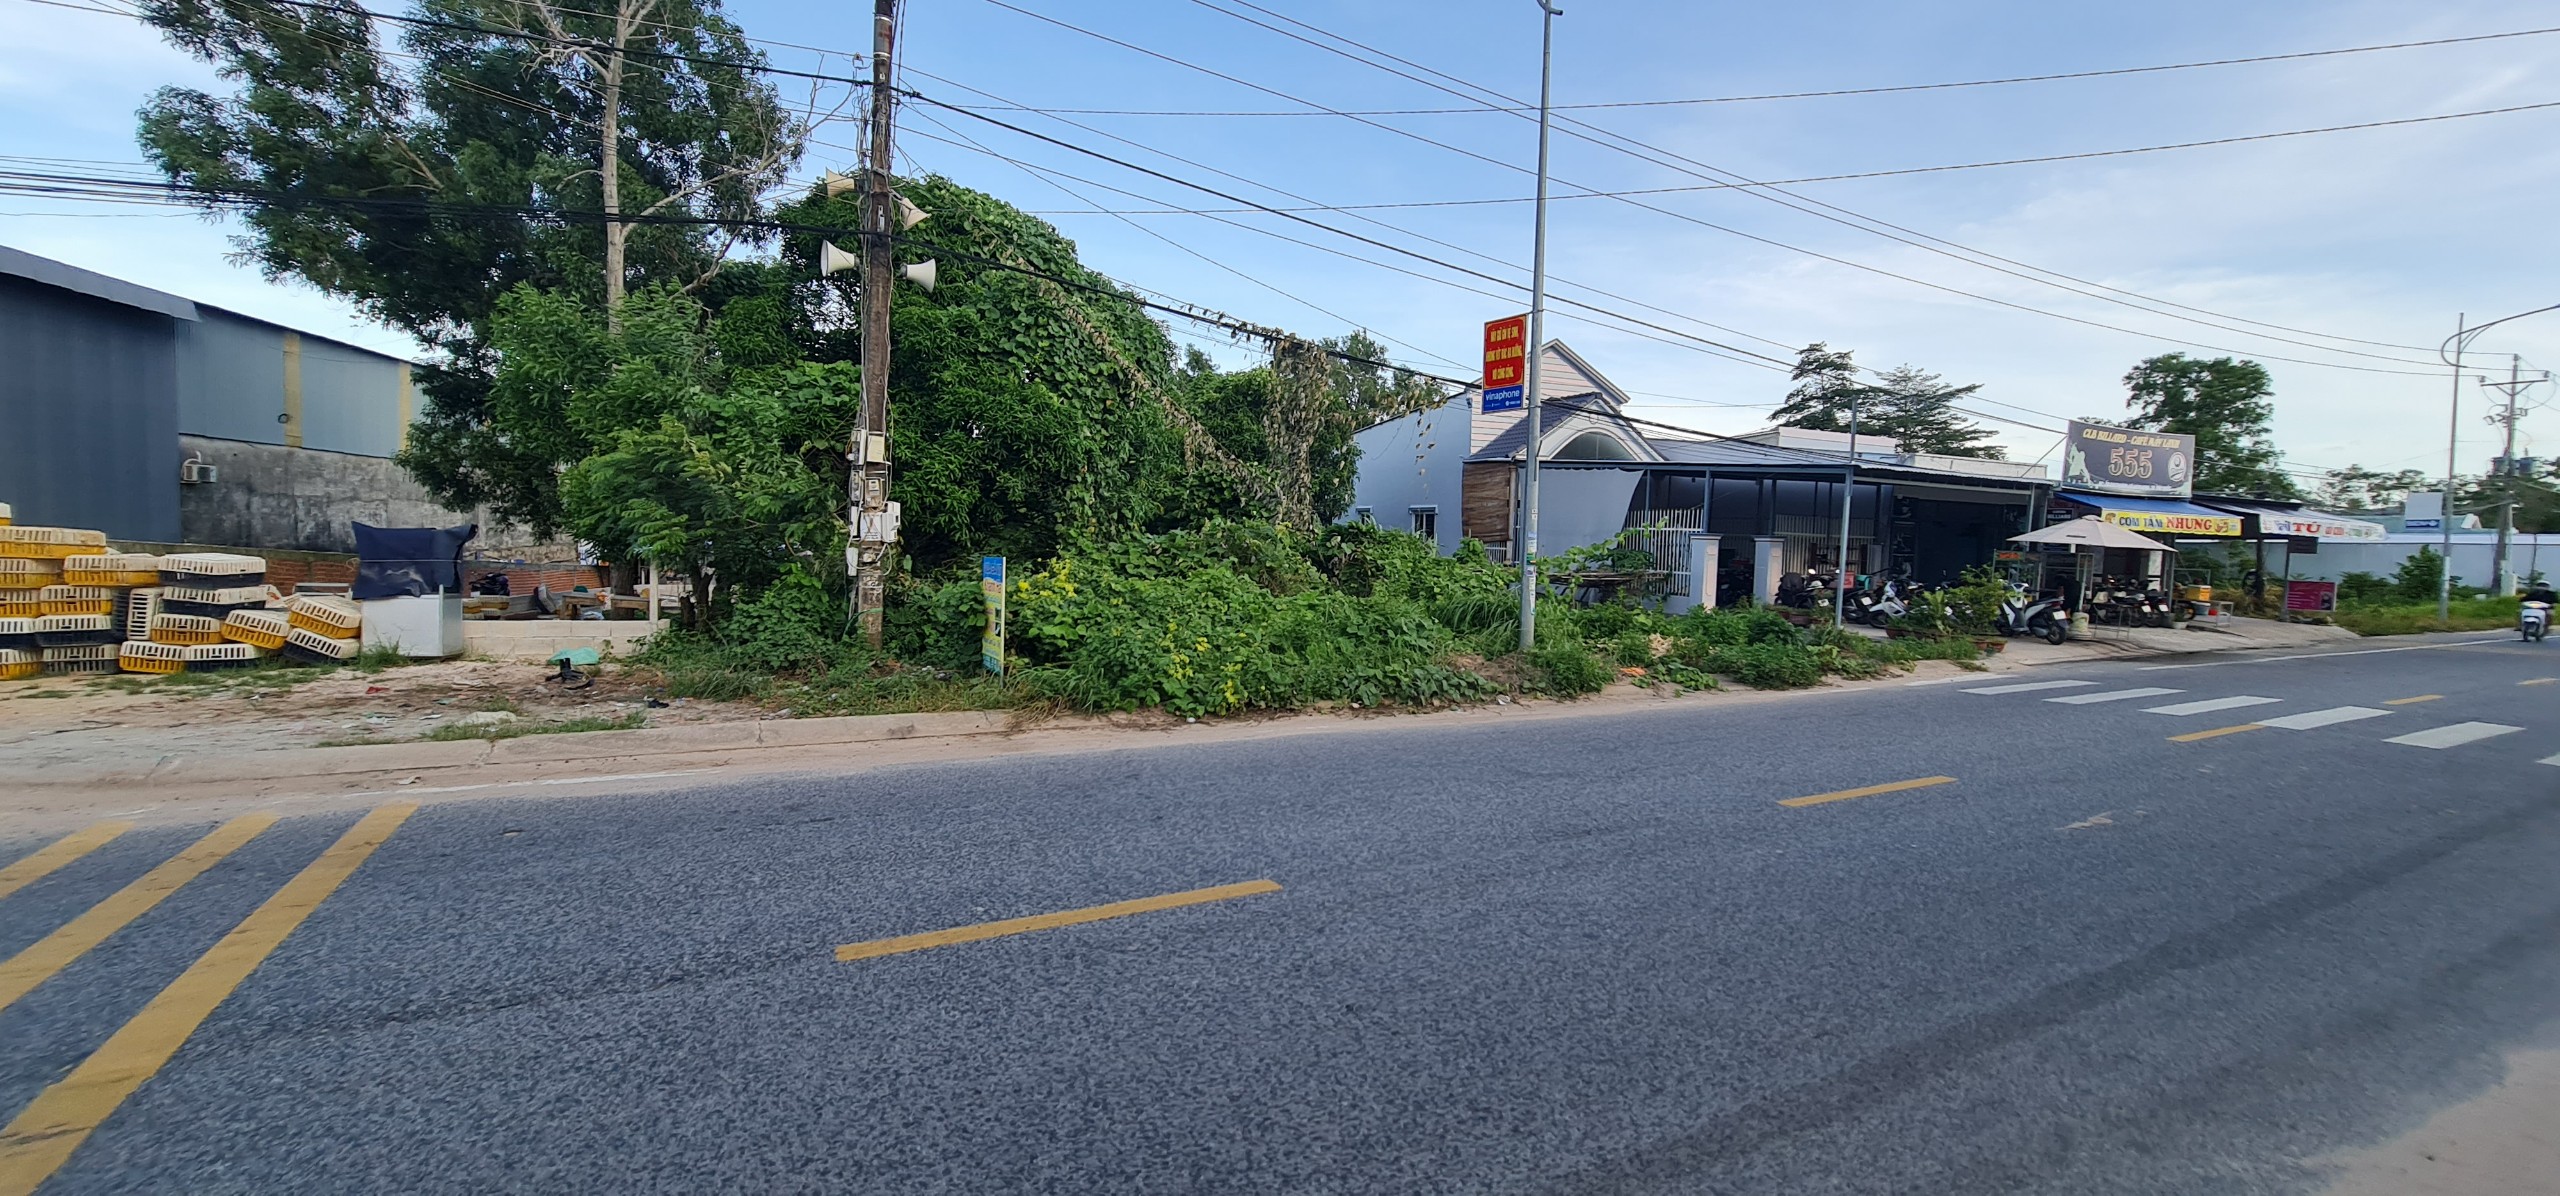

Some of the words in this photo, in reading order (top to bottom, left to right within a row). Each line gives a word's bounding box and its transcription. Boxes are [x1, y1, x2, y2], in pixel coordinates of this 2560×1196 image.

[1485, 389, 1520, 401] vinaphone
[2108, 447, 2153, 479] 555
[2166, 516, 2213, 531] NHUNG
